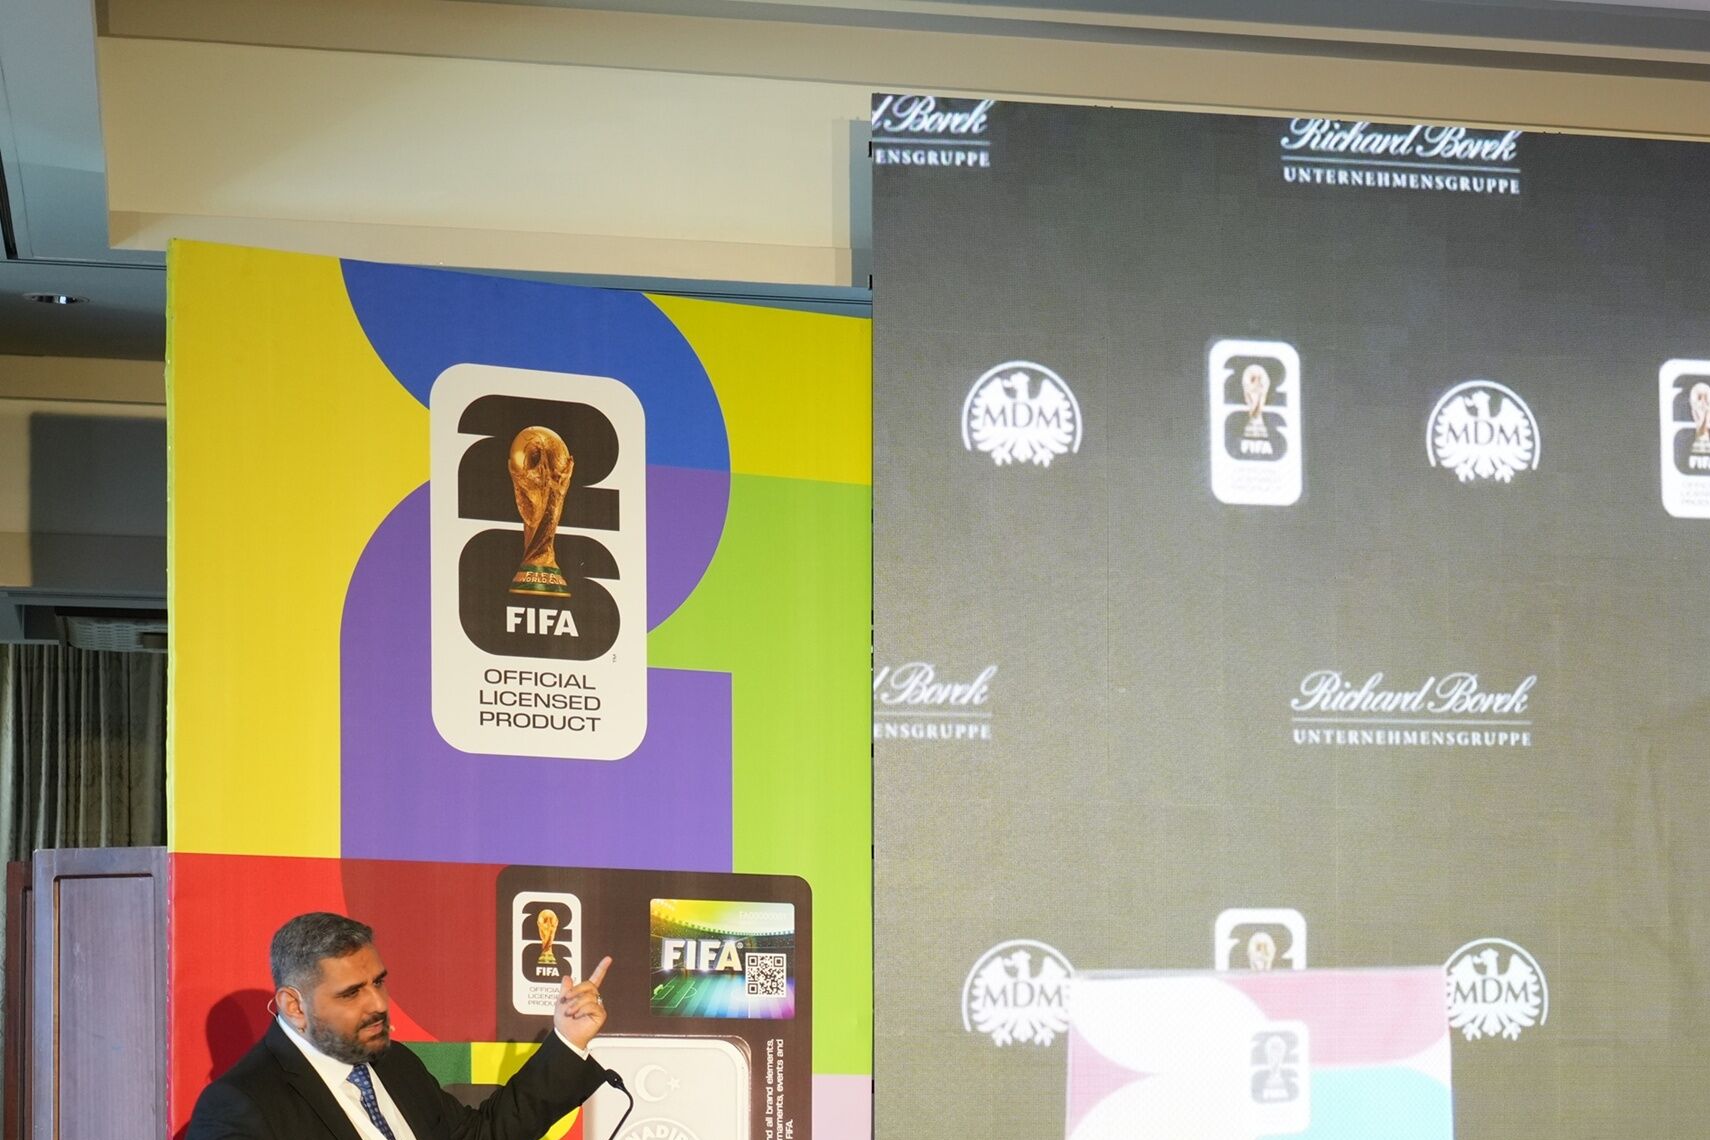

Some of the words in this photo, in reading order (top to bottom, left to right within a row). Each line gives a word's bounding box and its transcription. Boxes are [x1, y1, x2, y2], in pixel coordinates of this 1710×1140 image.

[1280, 118, 1421, 156] Richard
[1283, 166, 1521, 194] UNTERNEHMENSGRUPPE
[982, 402, 1061, 428] MDM
[1447, 420, 1521, 446] MDM
[506, 606, 579, 637] FIFA
[484, 668, 597, 690] OFFICIAL
[1291, 670, 1435, 712] Richard
[1427, 672, 1537, 713] Borek
[479, 690, 601, 711] LICENSED
[479, 711, 601, 732] PRODUCT
[1293, 729, 1532, 746] UNTERNEHMENSGRUPPE
[536, 966, 560, 977] FIFA
[982, 981, 1063, 1008] MDM
[1453, 977, 1529, 1003] MDM
[775, 1039, 784, 1057] and
[775, 1060, 784, 1092] events
[765, 1087, 773, 1115] brand
